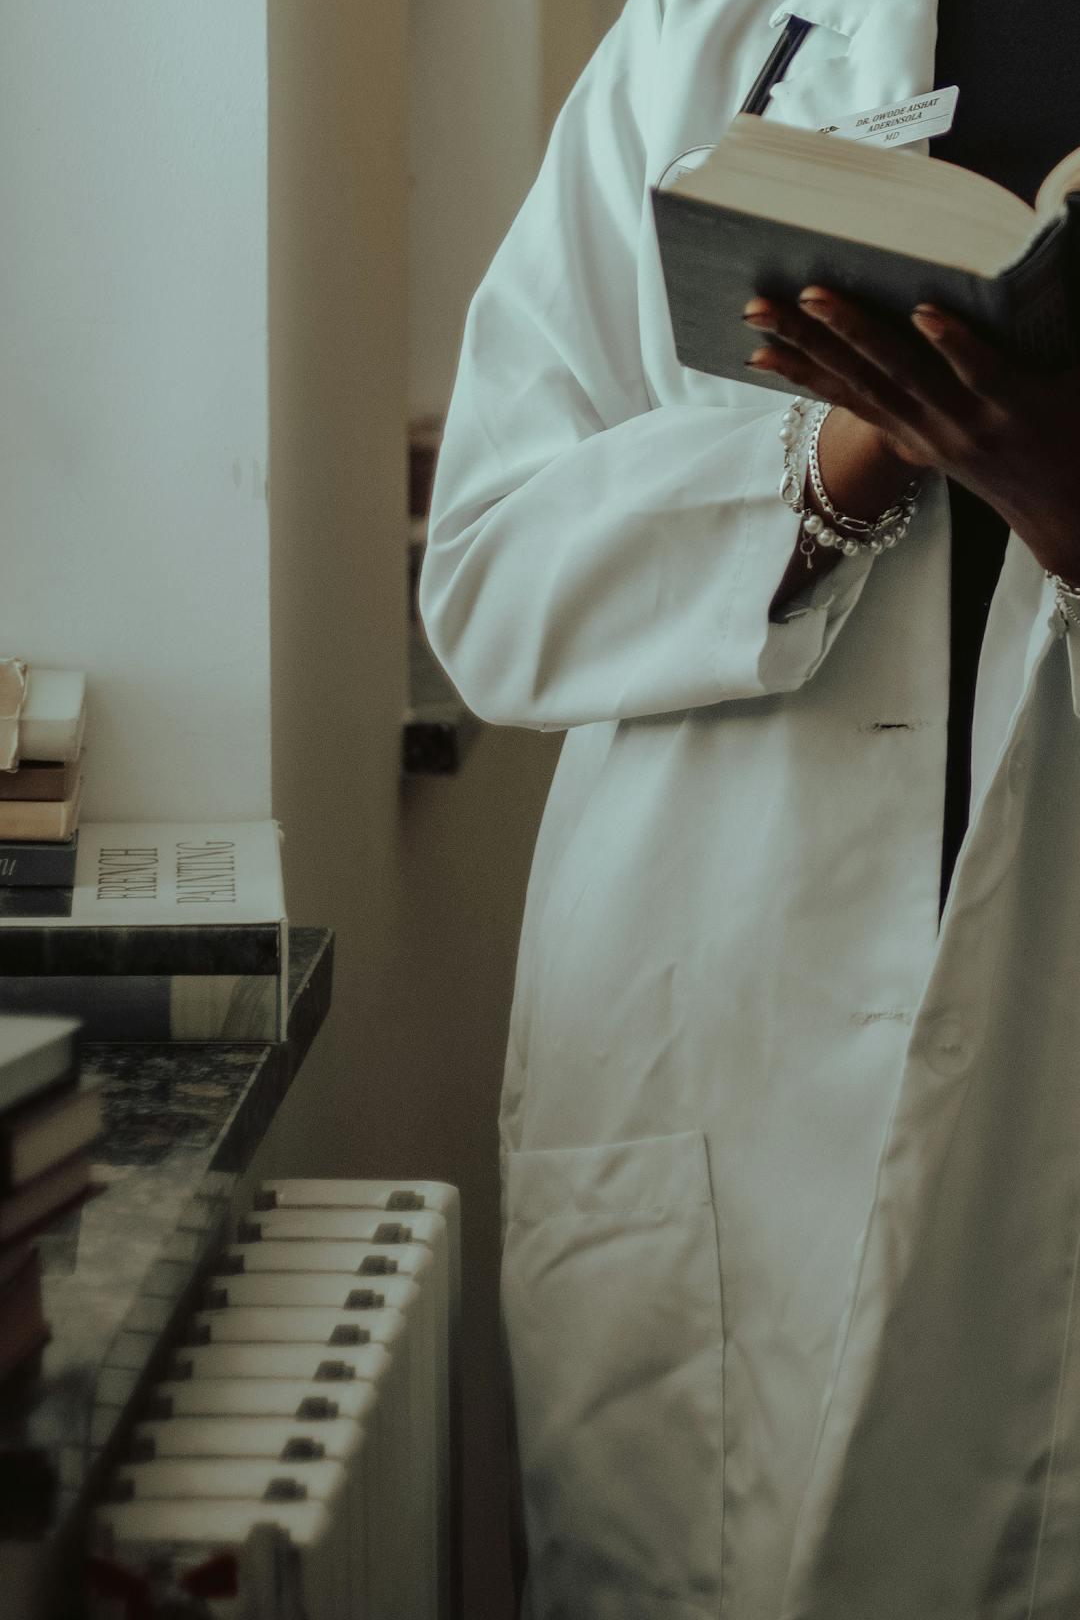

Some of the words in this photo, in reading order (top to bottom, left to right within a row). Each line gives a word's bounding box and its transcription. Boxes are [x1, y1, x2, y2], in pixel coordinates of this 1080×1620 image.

[866, 111, 923, 133] ADERINSOLA
[872, 105, 908, 123] OWODE
[907, 97, 941, 114] AISHAT
[883, 131, 901, 142] MD
[96, 847, 159, 901] FRENCH
[175, 840, 236, 904] PAINTING
